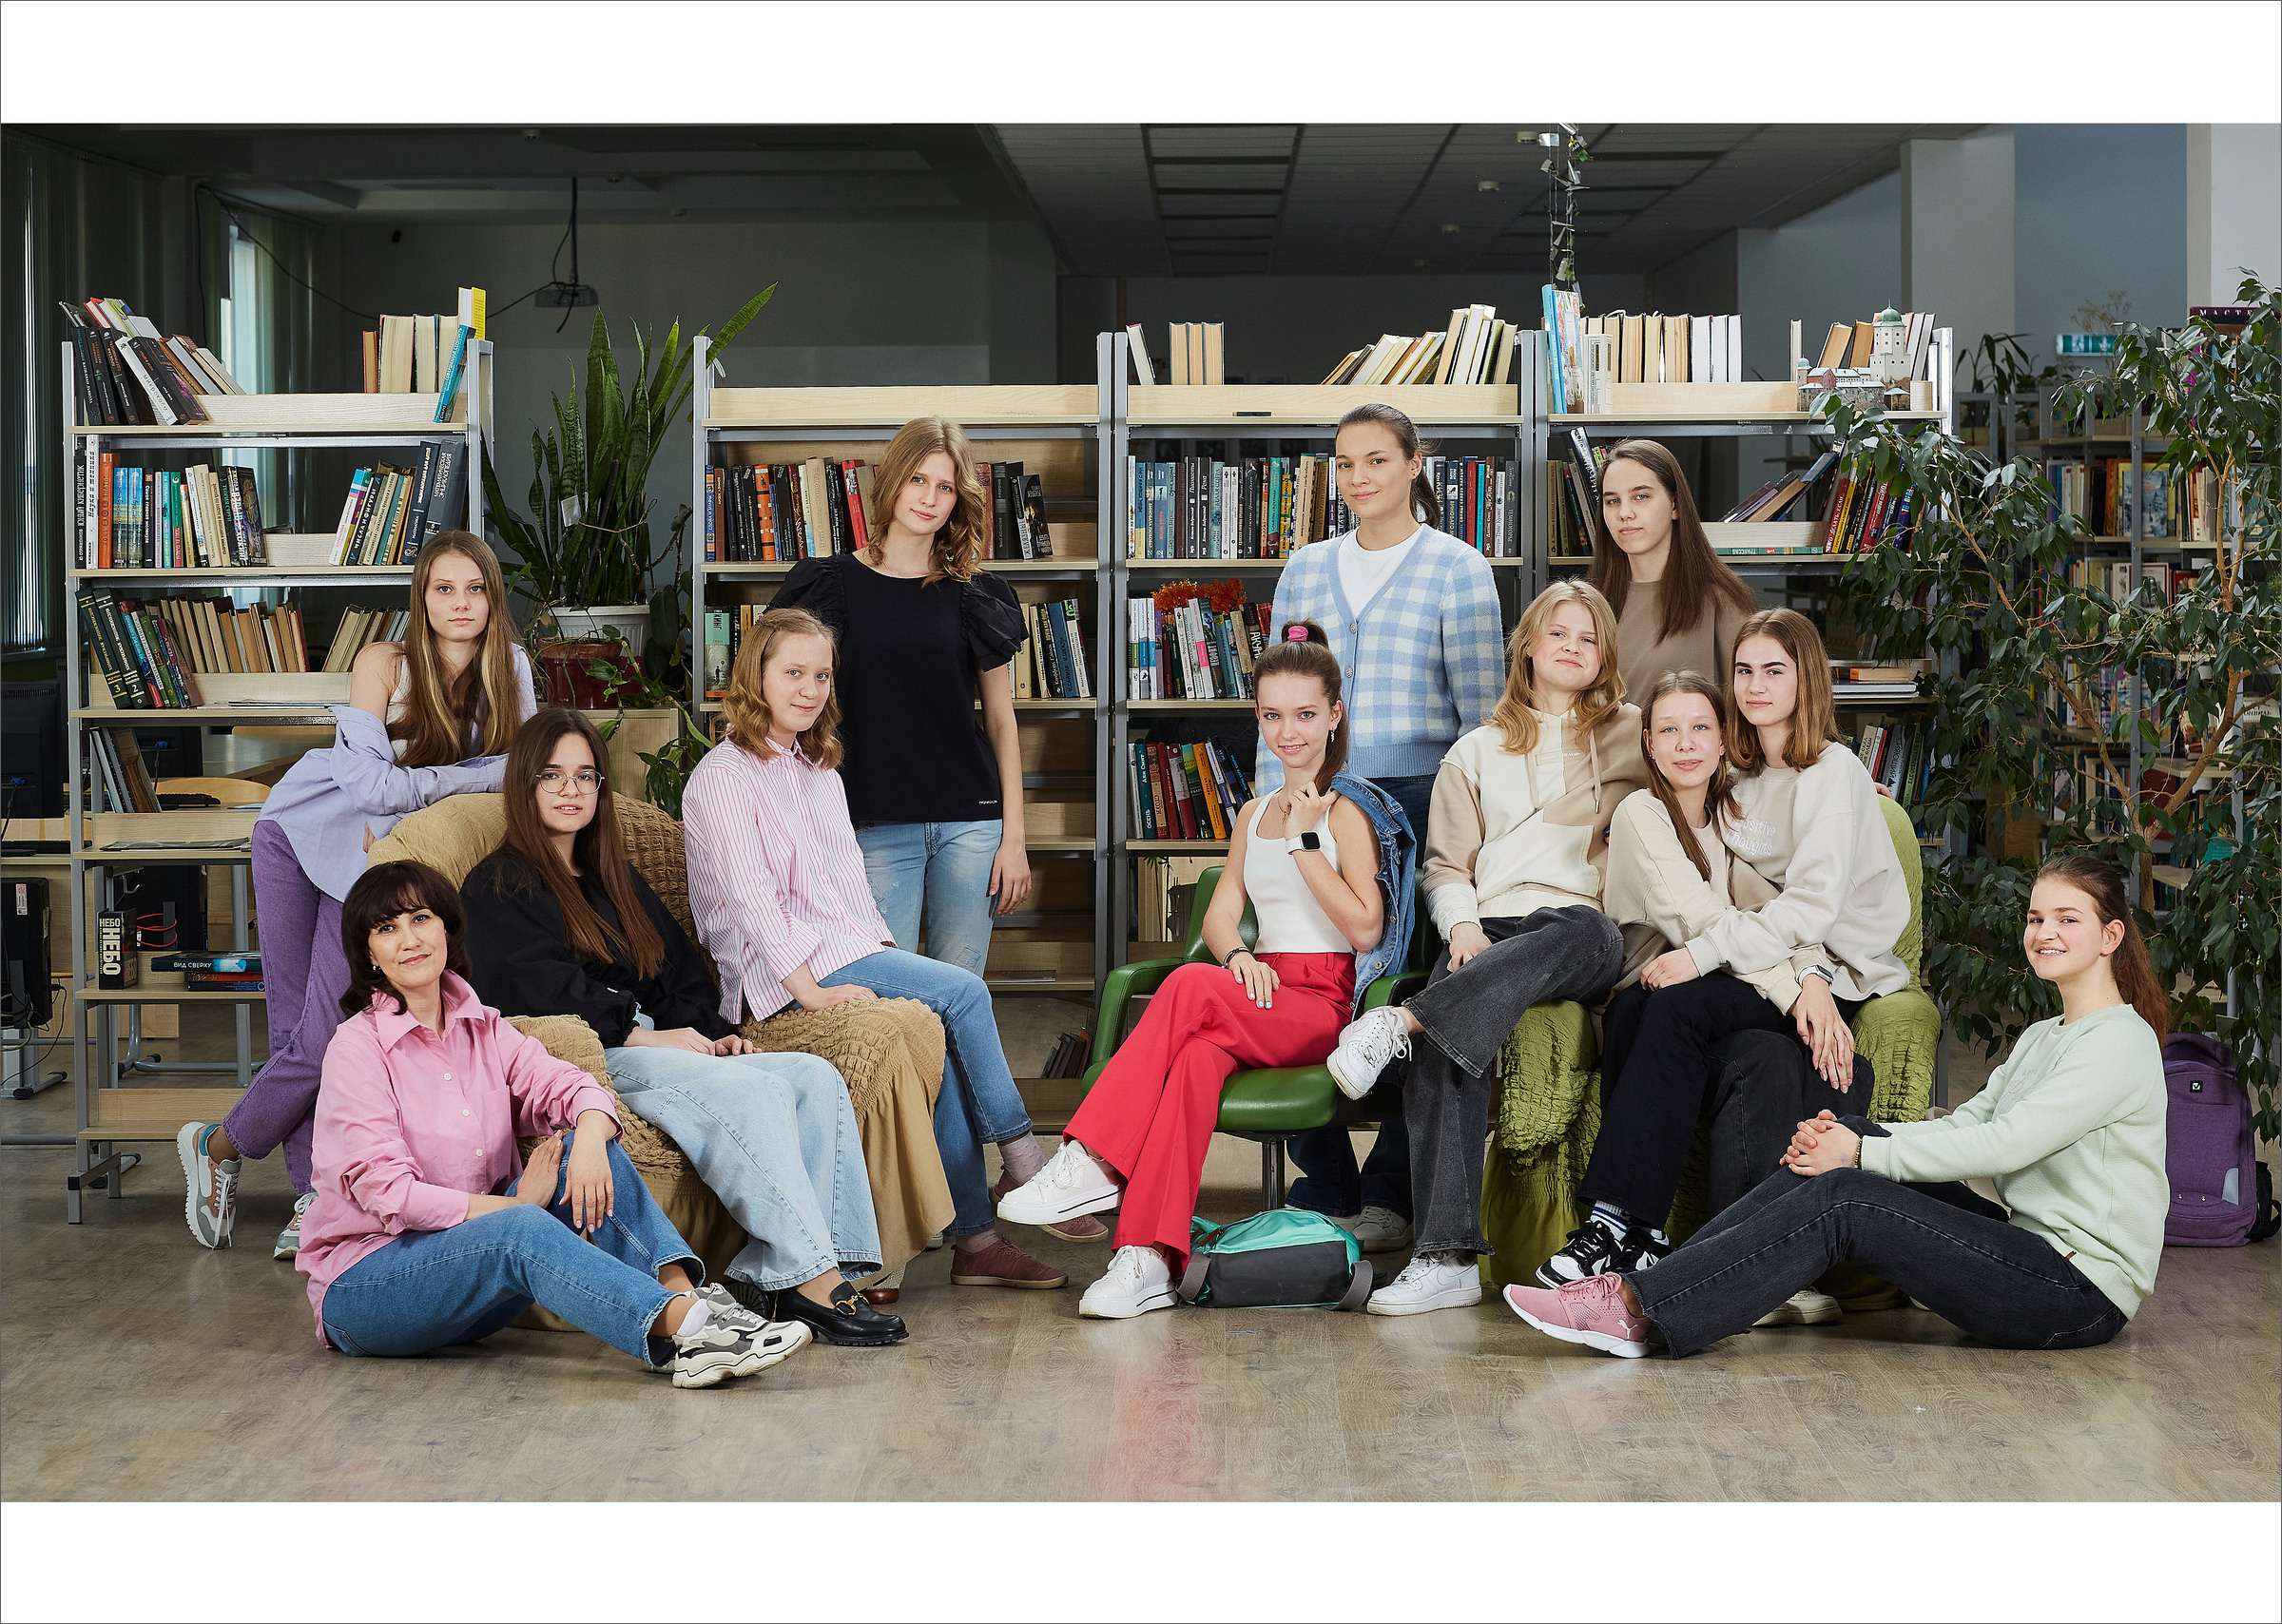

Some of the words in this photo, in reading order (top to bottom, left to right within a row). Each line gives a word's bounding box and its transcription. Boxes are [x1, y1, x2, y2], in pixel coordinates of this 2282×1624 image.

[434, 452, 447, 498] МАТЕМАТИЧЕСКАЯ
[439, 453, 453, 499] ЭНЦИКЛОПЕДИЯ
[76, 465, 86, 505] КИБЕРНЕТИК
[76, 507, 85, 526] ЮНЫЙ
[354, 525, 366, 549] ЧИСЛА
[363, 488, 377, 518] ФИГУРЫ
[713, 614, 722, 629] КИНГ
[113, 684, 122, 693] 3
[131, 684, 139, 693] 2
[1864, 736, 1872, 754] СЛЕДЫ
[99, 918, 121, 927] НЕБО
[102, 928, 121, 976] НЕБО
